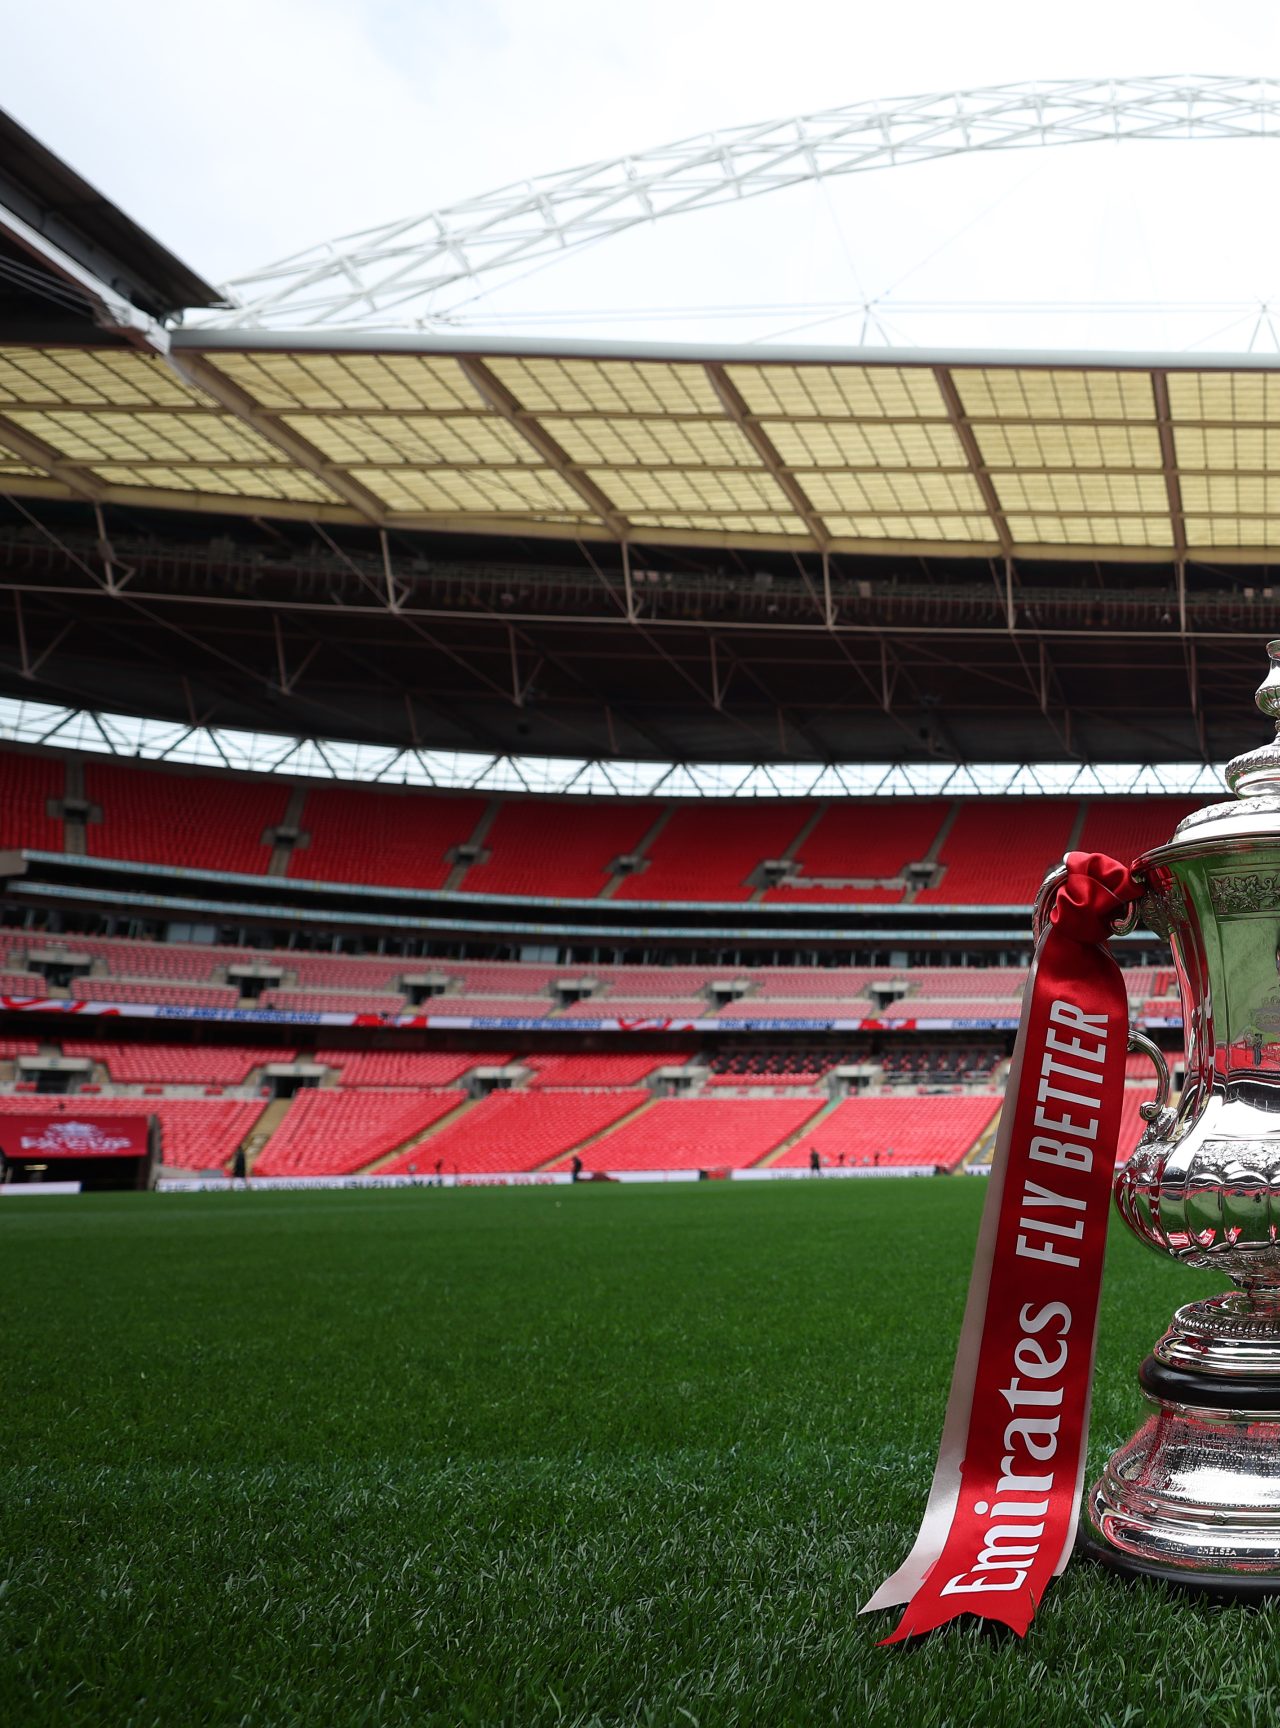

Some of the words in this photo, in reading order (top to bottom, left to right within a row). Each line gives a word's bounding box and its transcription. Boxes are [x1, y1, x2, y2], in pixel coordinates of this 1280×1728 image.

[1029, 1000, 1109, 1173] BETTER
[1015, 1179, 1087, 1268] FLY
[940, 1301, 1072, 1597] Emirates
[1197, 1546, 1238, 1557] CHELSEA
